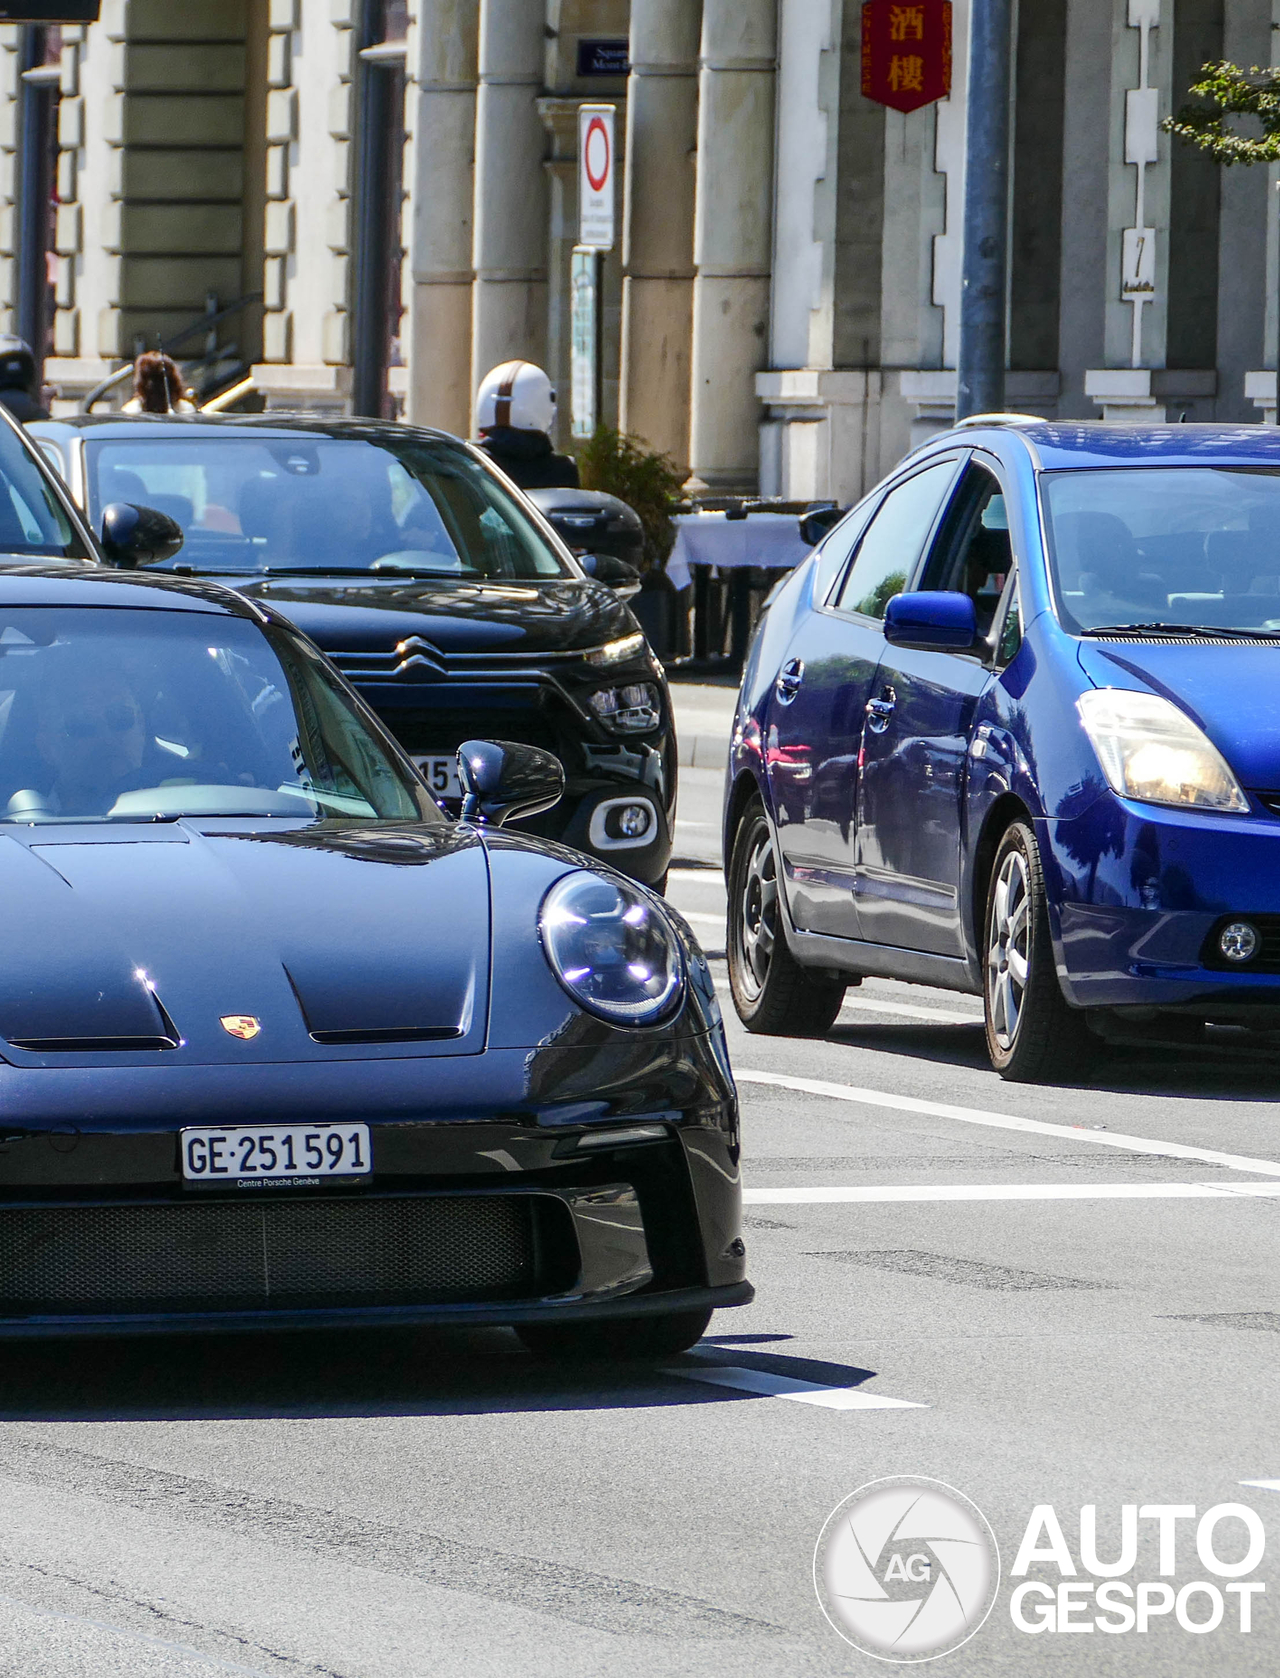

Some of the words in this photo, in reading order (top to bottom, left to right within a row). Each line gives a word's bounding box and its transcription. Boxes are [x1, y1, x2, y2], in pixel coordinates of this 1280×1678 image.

[862, 4, 872, 92] CHINESE
[887, 4, 925, 91] 酒樓
[237, 1179, 262, 1188] Centre
[263, 1178, 291, 1187] Porsche
[293, 1177, 320, 1186] Genève
